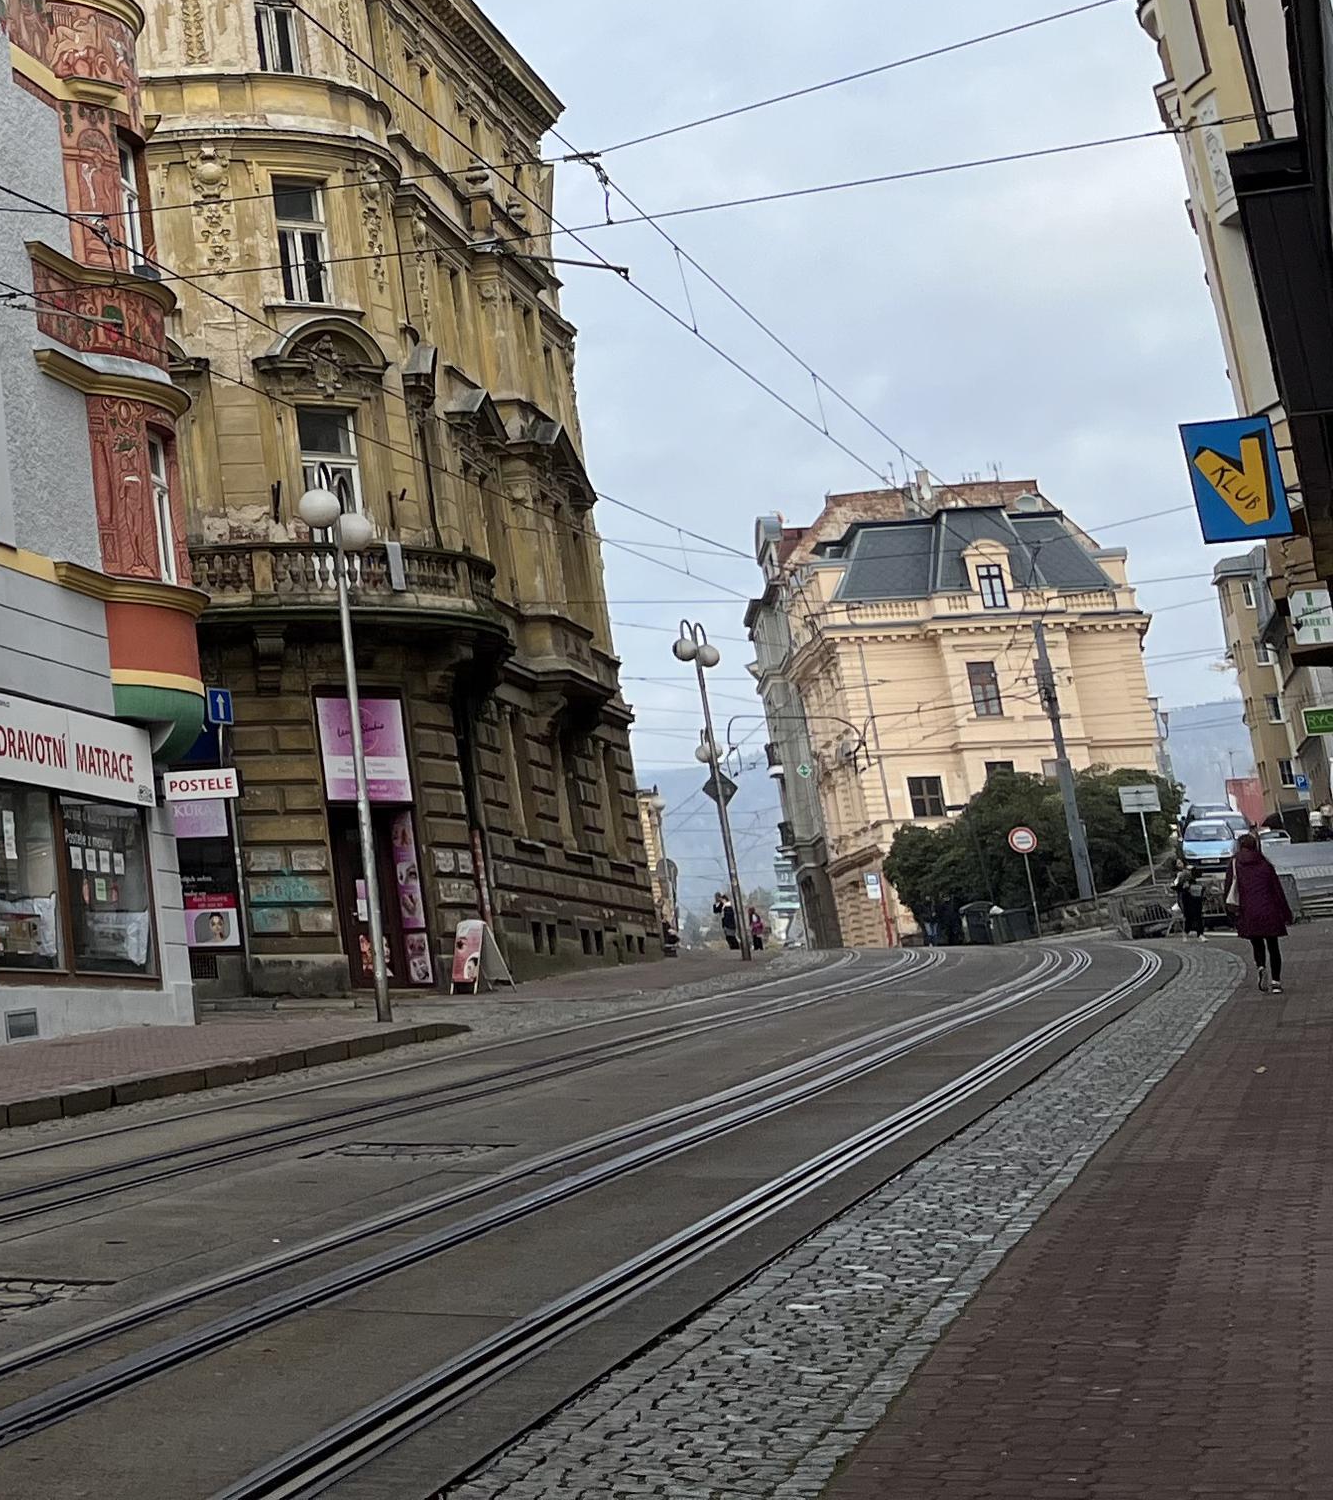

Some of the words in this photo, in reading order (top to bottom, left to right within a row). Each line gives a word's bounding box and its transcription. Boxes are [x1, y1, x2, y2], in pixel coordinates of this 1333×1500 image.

[1210, 465, 1261, 510] KLUB
[75, 742, 135, 783] MATRACE
[169, 777, 233, 793] POSTELE
